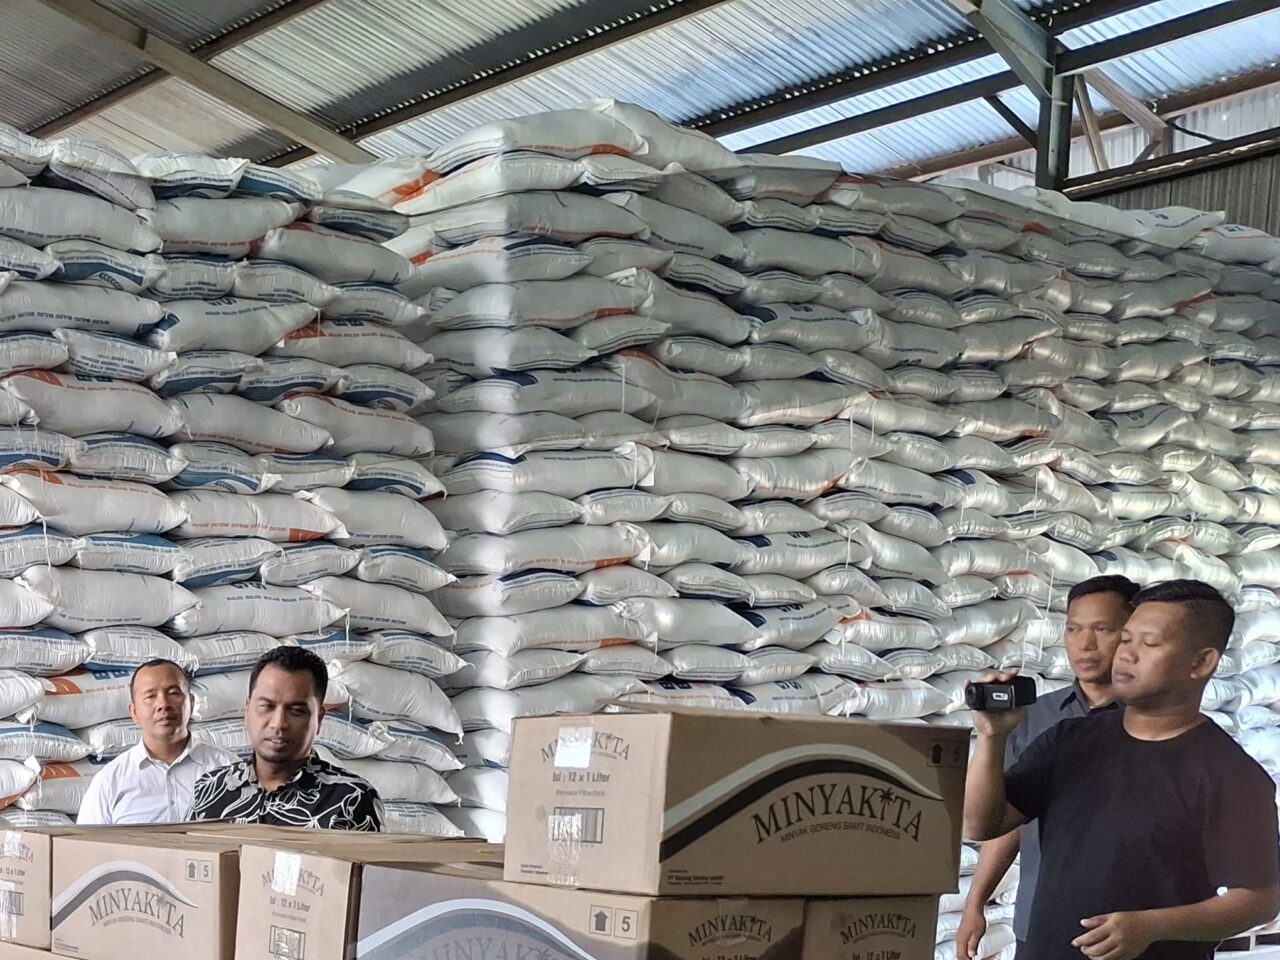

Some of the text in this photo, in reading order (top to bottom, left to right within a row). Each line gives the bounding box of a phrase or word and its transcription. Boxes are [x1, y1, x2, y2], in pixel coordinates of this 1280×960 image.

[568, 771, 577, 782] 12
[592, 772, 610, 783] Liter
[751, 783, 922, 844] MINYAKITA
[88, 887, 185, 939] MINYAKITA
[621, 915, 631, 932] 5
[840, 912, 917, 945] MINYAKITA
[688, 915, 773, 947] MINYAKITA
